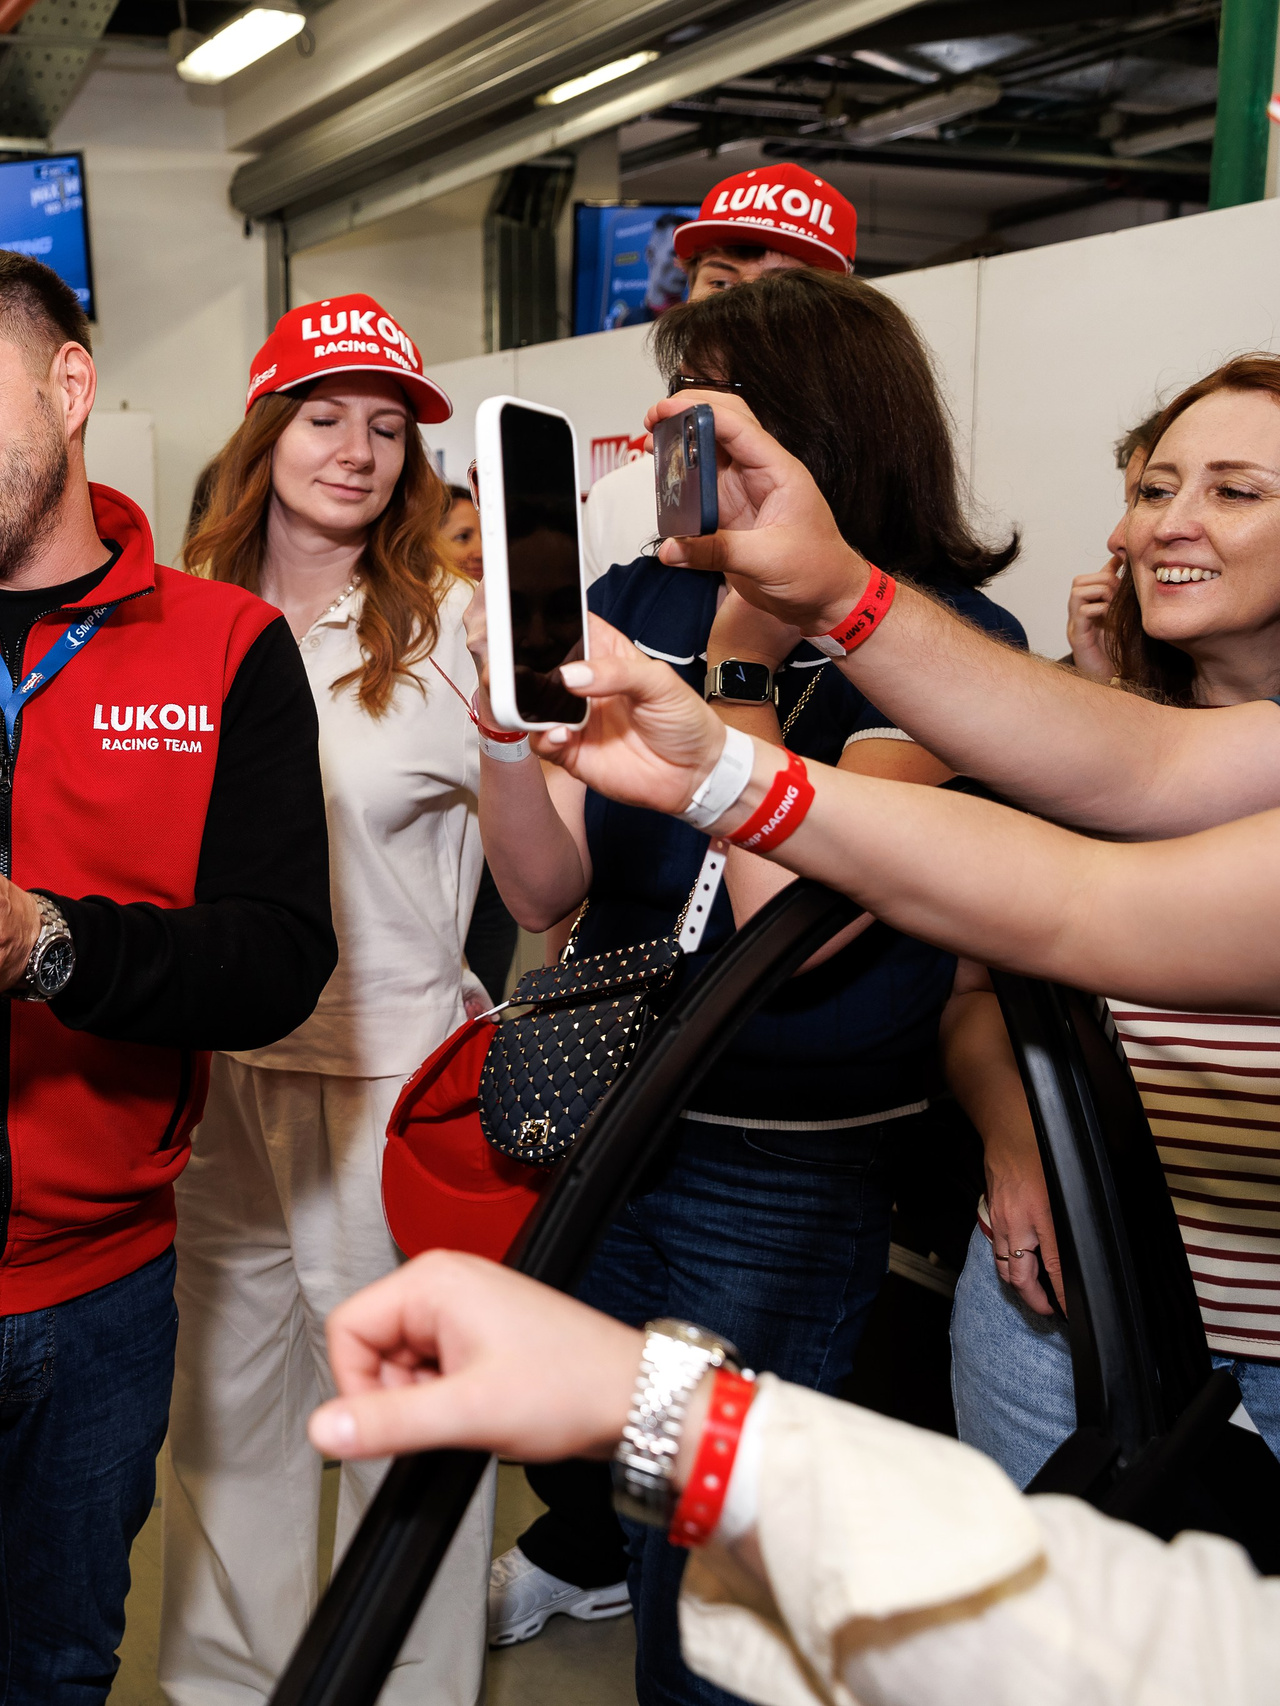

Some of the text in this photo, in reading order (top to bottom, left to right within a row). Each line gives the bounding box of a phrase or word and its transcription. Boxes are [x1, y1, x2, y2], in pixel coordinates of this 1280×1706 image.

[712, 184, 835, 235] LUKOIL
[302, 310, 418, 368] LUKOIL
[314, 340, 380, 358] RACING
[75, 615, 95, 638] SMP
[845, 619, 866, 640] SMP
[93, 703, 214, 732] LUKOIL
[102, 737, 202, 753] RACING TEAM
[761, 785, 799, 835] RACING
